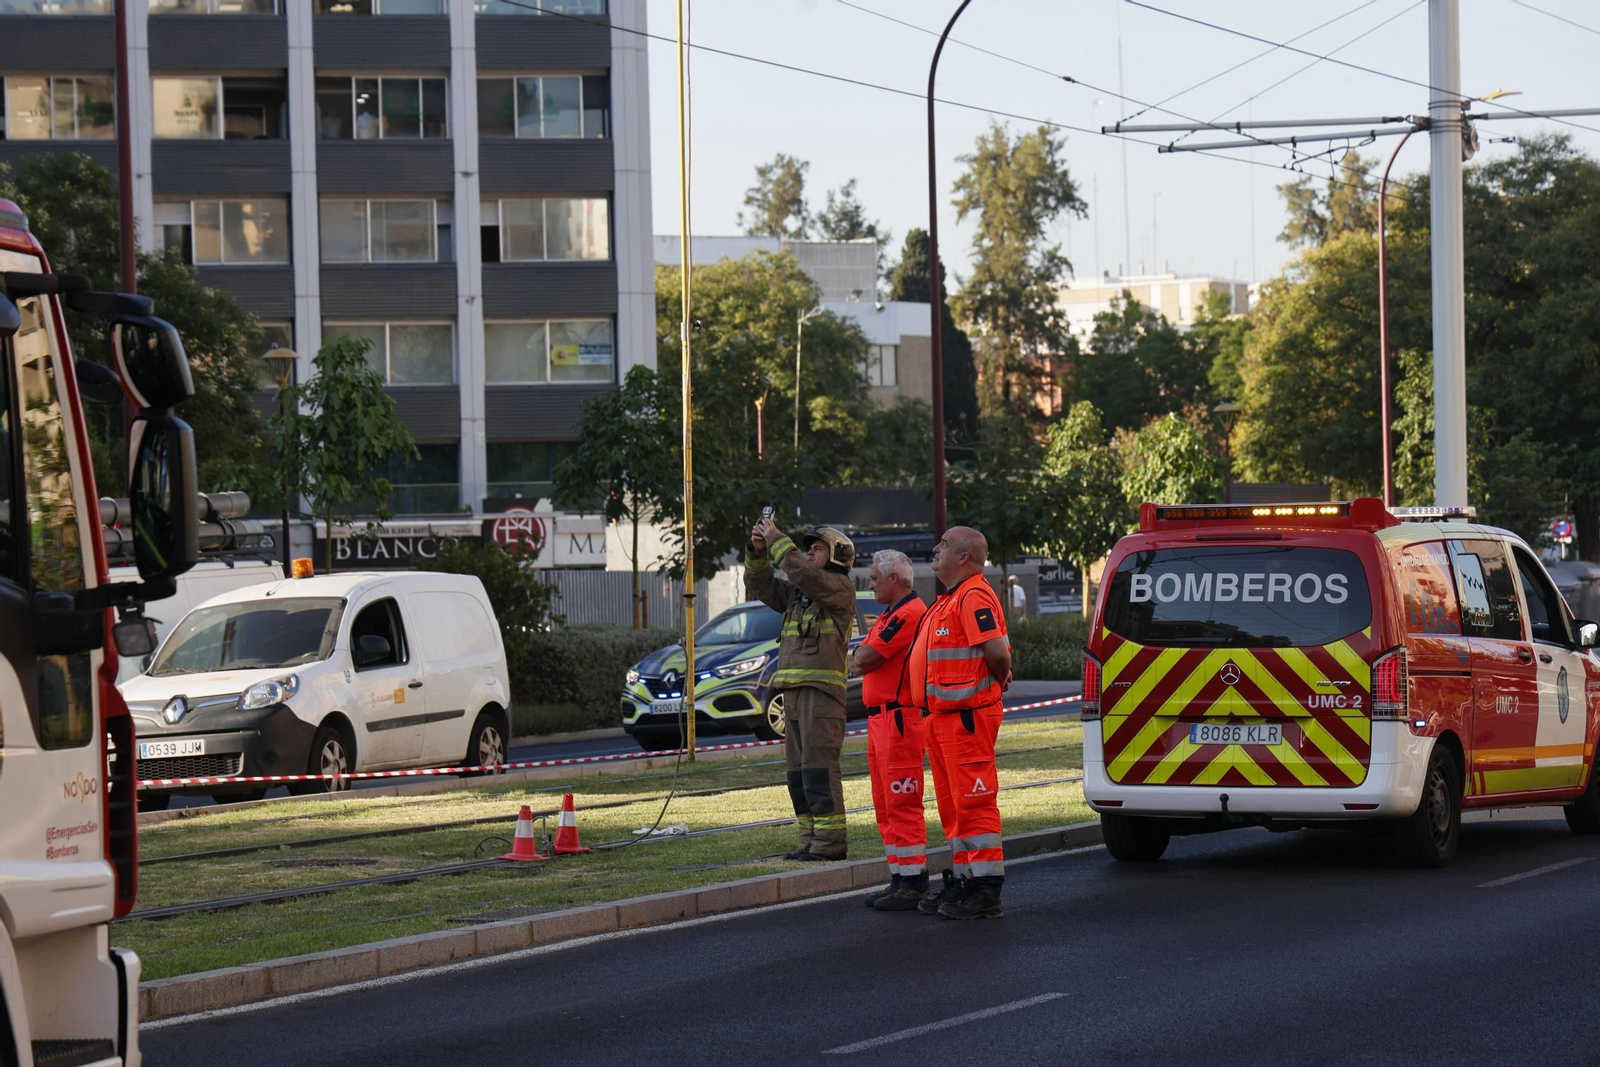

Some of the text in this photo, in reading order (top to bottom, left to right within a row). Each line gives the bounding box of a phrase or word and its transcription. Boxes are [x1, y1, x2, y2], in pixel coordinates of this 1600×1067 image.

[1130, 573, 1349, 604] BOMBEROS
[654, 703, 672, 712] 8200
[1308, 695, 1363, 708] UMC 2
[1495, 695, 1519, 714] UMC 2
[1200, 725, 1278, 741] 8086 KLR
[148, 742, 202, 756] 0539 JJM
